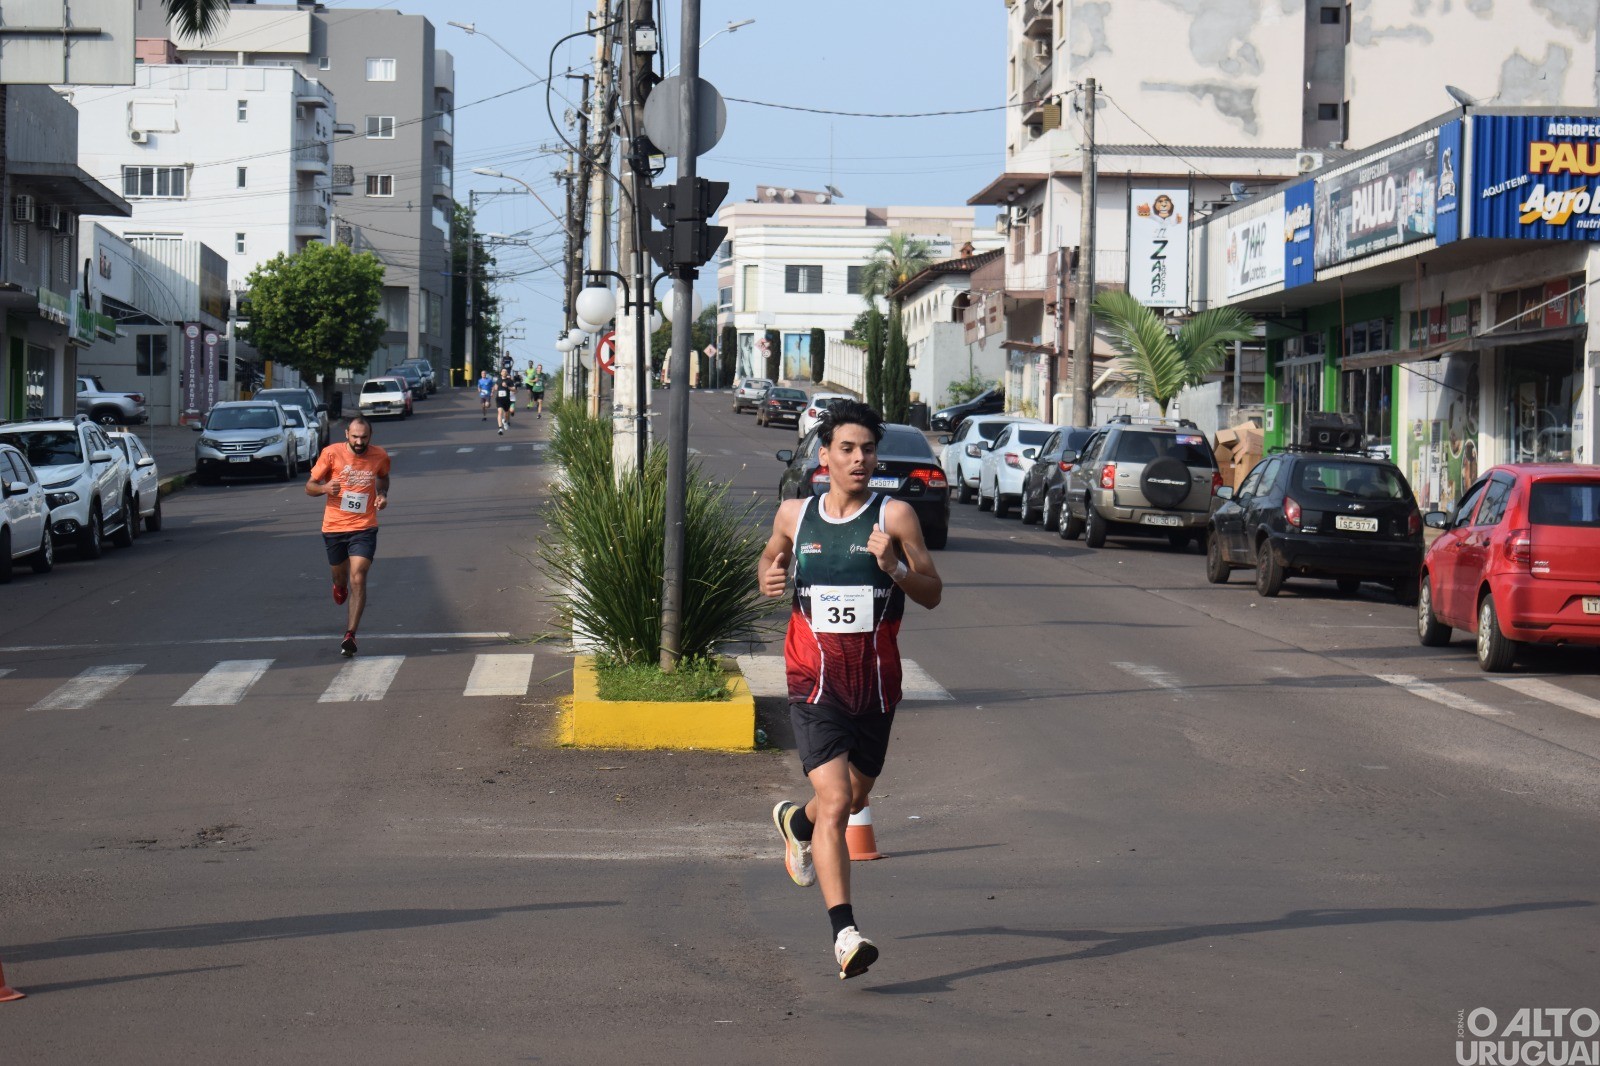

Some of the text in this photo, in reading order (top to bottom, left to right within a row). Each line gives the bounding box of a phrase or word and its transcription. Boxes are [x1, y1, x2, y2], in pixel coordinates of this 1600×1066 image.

[1548, 123, 1600, 137] AGROPEC
[1529, 142, 1600, 175] PAU
[1483, 175, 1528, 198] AQUI TEM!
[1351, 176, 1396, 233] PAULO
[1241, 221, 1266, 285] ZAAP
[1150, 240, 1168, 297] ZAAP
[348, 501, 361, 510] 59
[828, 606, 856, 624] 35
